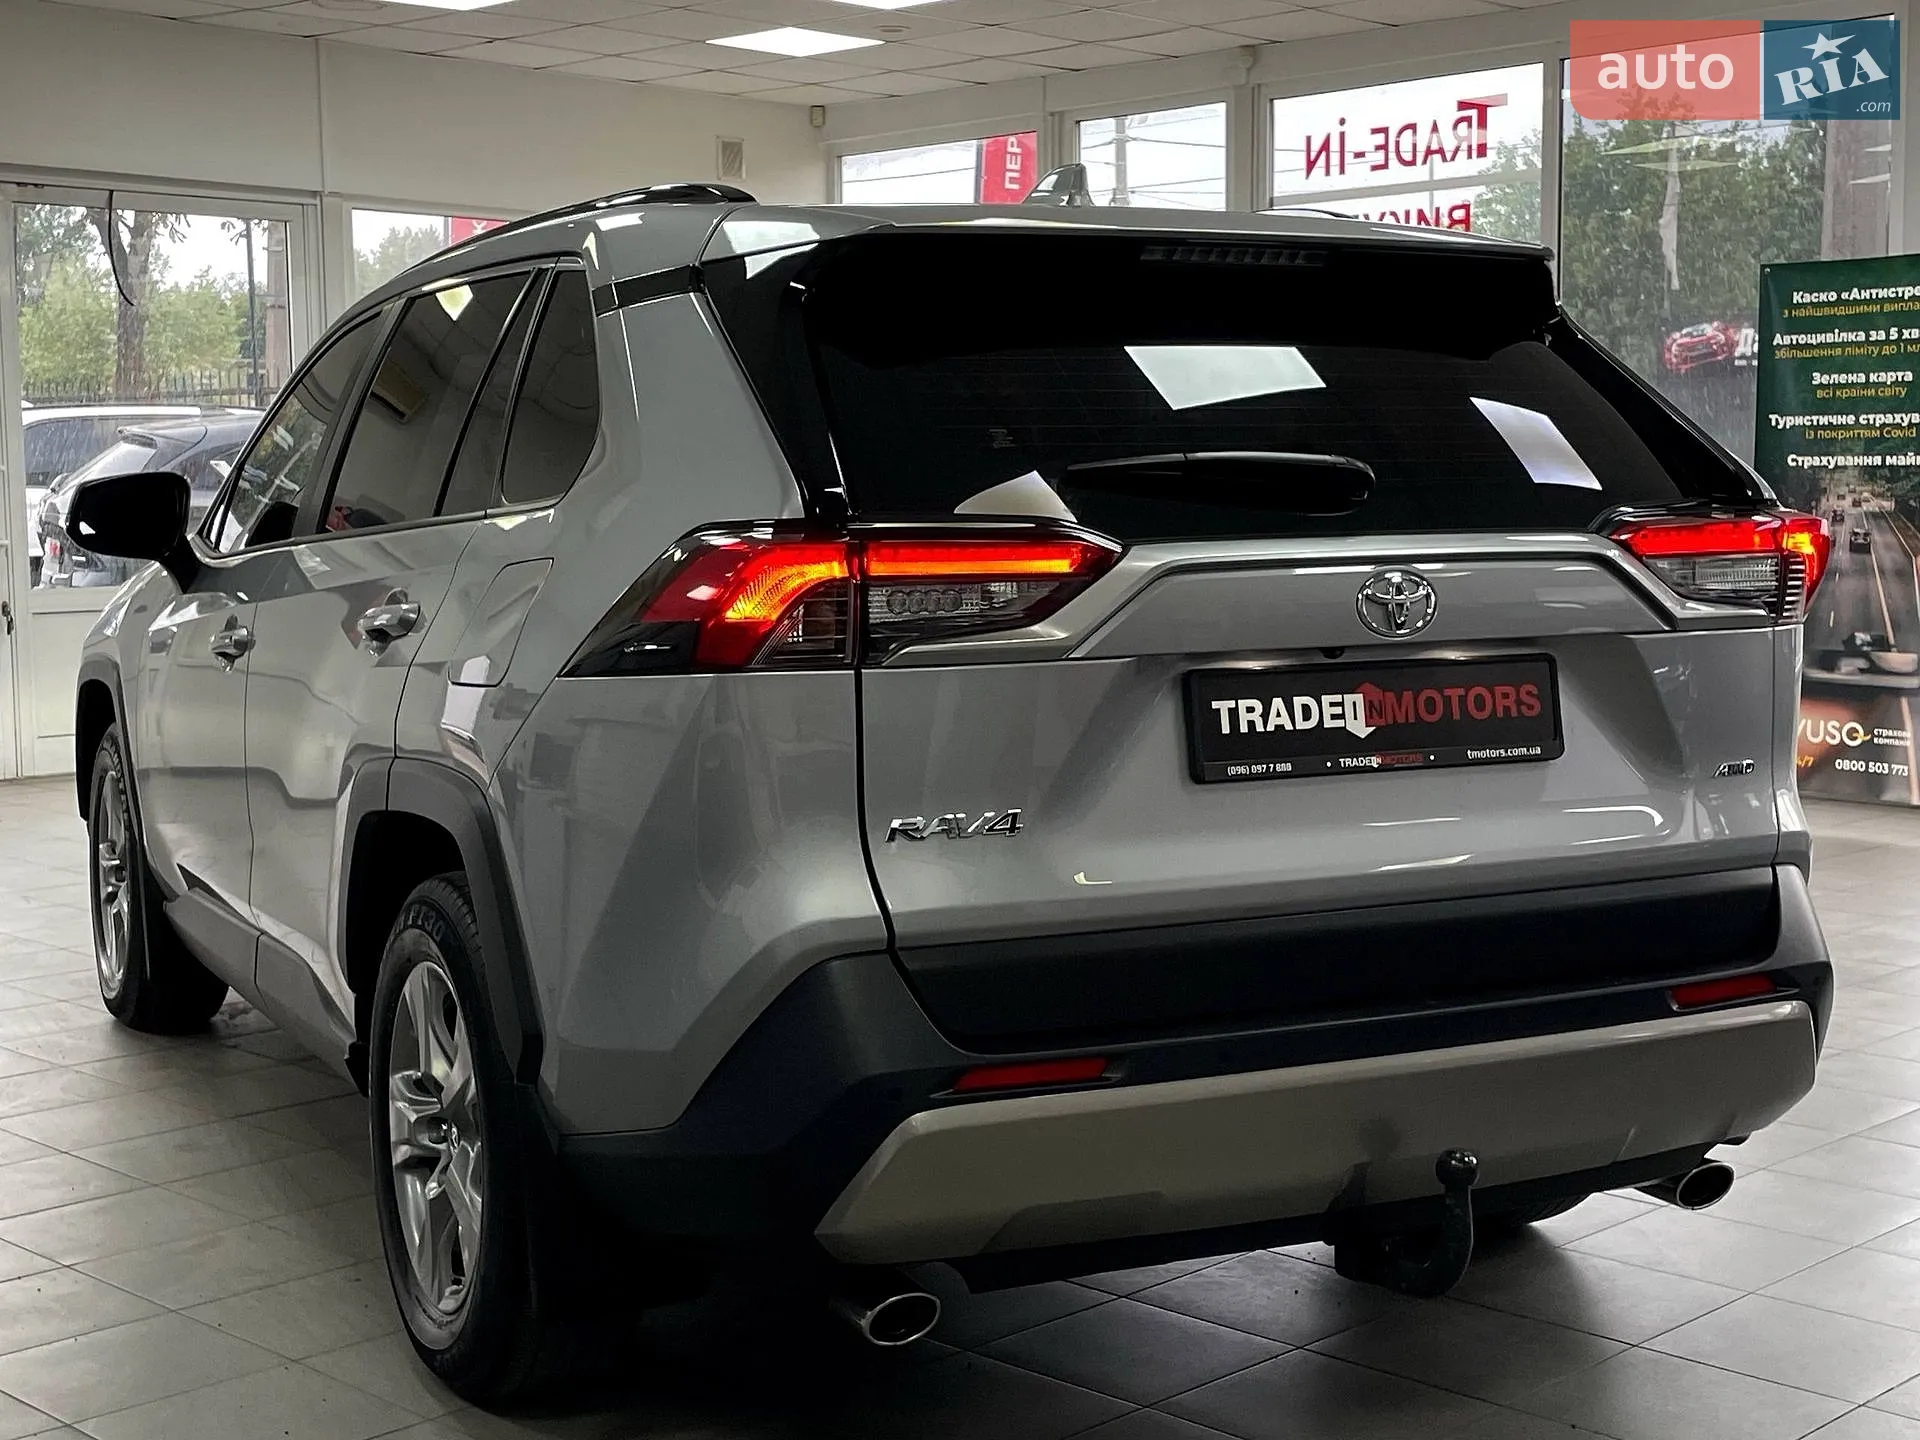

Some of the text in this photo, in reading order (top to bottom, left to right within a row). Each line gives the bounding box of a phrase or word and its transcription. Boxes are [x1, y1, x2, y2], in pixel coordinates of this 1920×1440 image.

[1792, 290, 1837, 304] Каско
[1792, 304, 1881, 318] найшвидшими
[1772, 328, 1866, 346] Автоцивілка
[1869, 330, 1886, 341] за
[1889, 326, 1899, 340] 5
[1774, 347, 1842, 360] збільшення
[1844, 343, 1879, 358] ліміту
[1881, 344, 1897, 356] до
[1899, 342, 1904, 353] 1
[1811, 370, 1913, 385] Зелена карта
[1817, 386, 1833, 398] всі
[1878, 385, 1907, 398] світу
[1768, 414, 1856, 429] Туристичне
[1805, 426, 1917, 440] із покриттям Covid
[1787, 453, 1882, 469] Страхування
[1466, 746, 1541, 759] tmotors.com.ua
[1227, 765, 1250, 776] (096)
[1251, 764, 1266, 774] 097
[1268, 763, 1274, 772] 7
[1834, 758, 1909, 776] 0800 503 773
[885, 808, 1024, 843] RAV4
